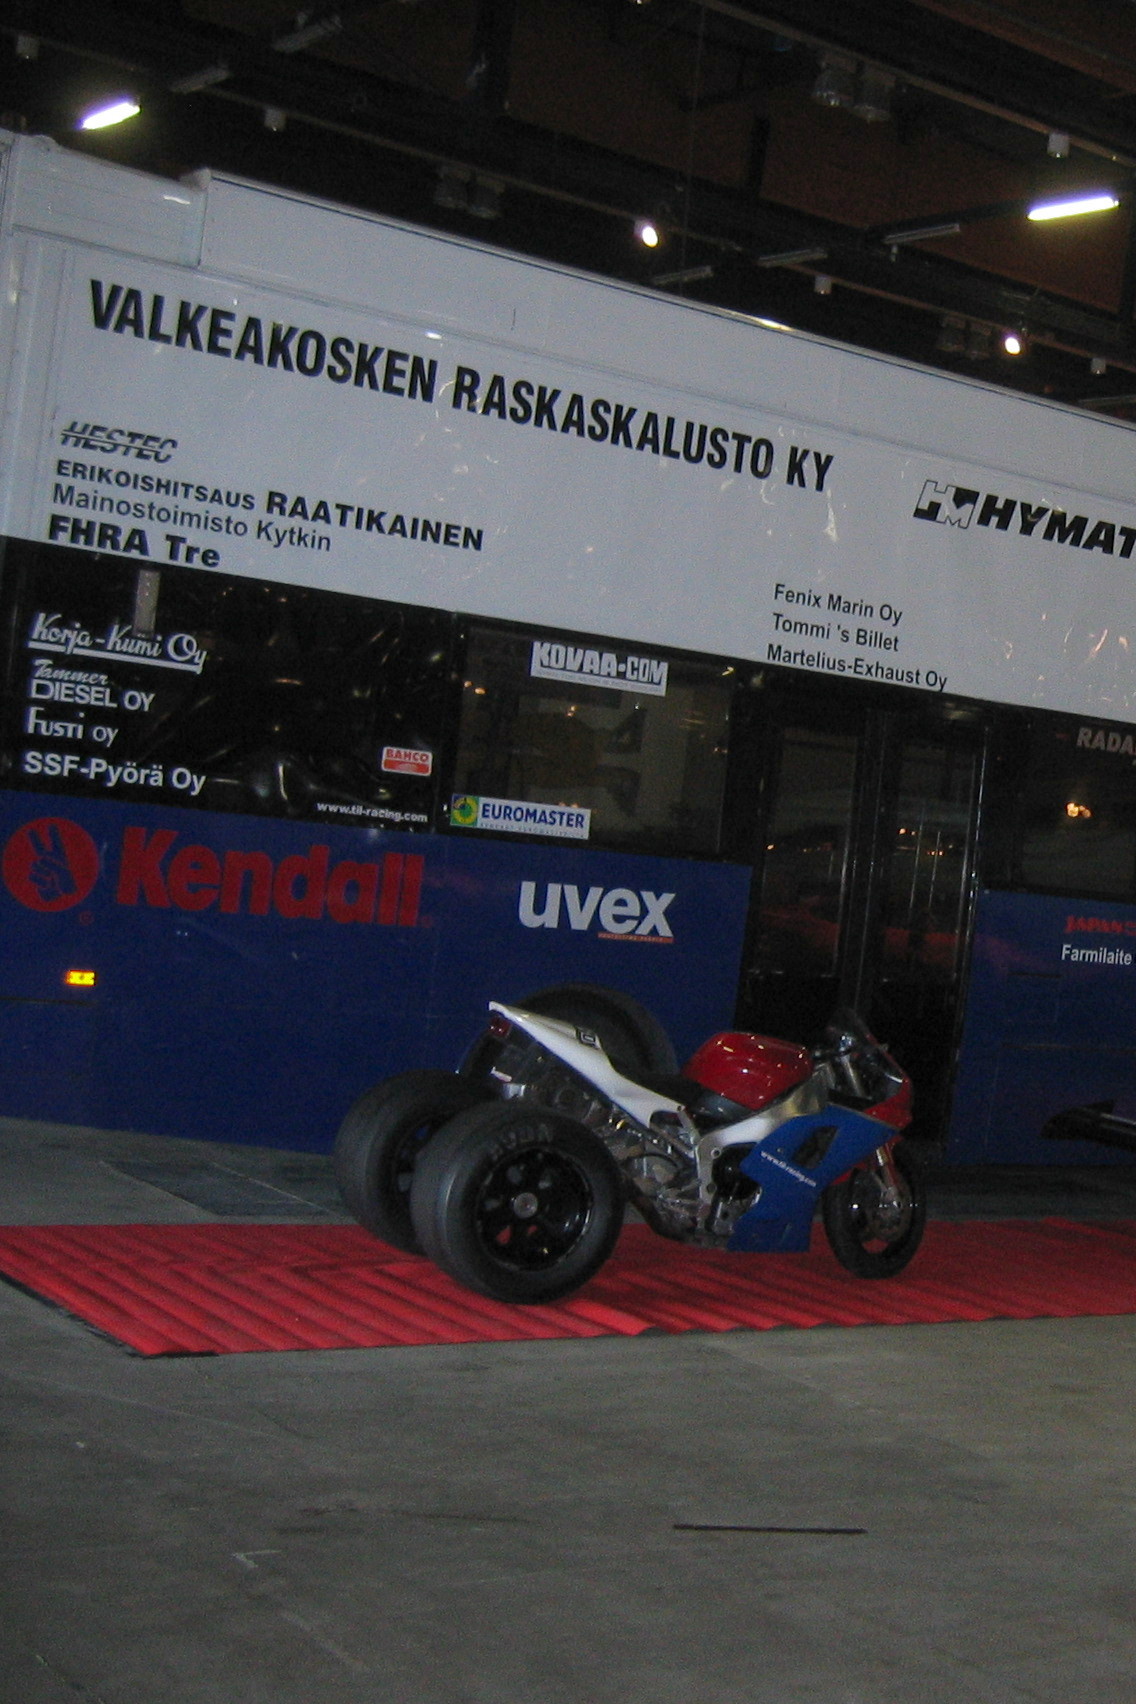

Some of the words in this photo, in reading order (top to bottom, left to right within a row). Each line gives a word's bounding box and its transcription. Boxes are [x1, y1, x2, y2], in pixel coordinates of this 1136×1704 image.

[90, 279, 438, 403] VALKEAKOSKEN
[451, 365, 774, 480] RASKASKALUSTO
[786, 446, 834, 492] KY
[60, 420, 178, 464] HESTEC
[52, 483, 249, 537] Mainostoimisto
[256, 520, 331, 553] Kytkin
[56, 459, 256, 511] ERIKOISHITSAUS
[265, 490, 485, 552] RAATIKAINEN
[47, 513, 150, 557] FHRA
[165, 534, 220, 569] Tre
[774, 582, 822, 609] Fenix
[827, 593, 875, 619] Marin
[879, 603, 903, 627] Oy
[167, 633, 207, 674] Oy
[772, 612, 831, 640] Tommi
[856, 627, 900, 653] Billet
[767, 643, 921, 687] Martelius-Exhaust
[925, 669, 948, 692] Oy
[30, 679, 118, 708] DIESEL
[124, 690, 155, 713] OY
[24, 751, 163, 788] SSF-Pyörä
[171, 767, 206, 795] Oy
[386, 748, 429, 763] BAHCO
[316, 801, 428, 823] www.til-racing.com
[482, 803, 585, 828] EUROMASTER
[117, 825, 425, 927] Kendall
[518, 880, 676, 937] uvex
[1061, 944, 1132, 966] Farmilaite
